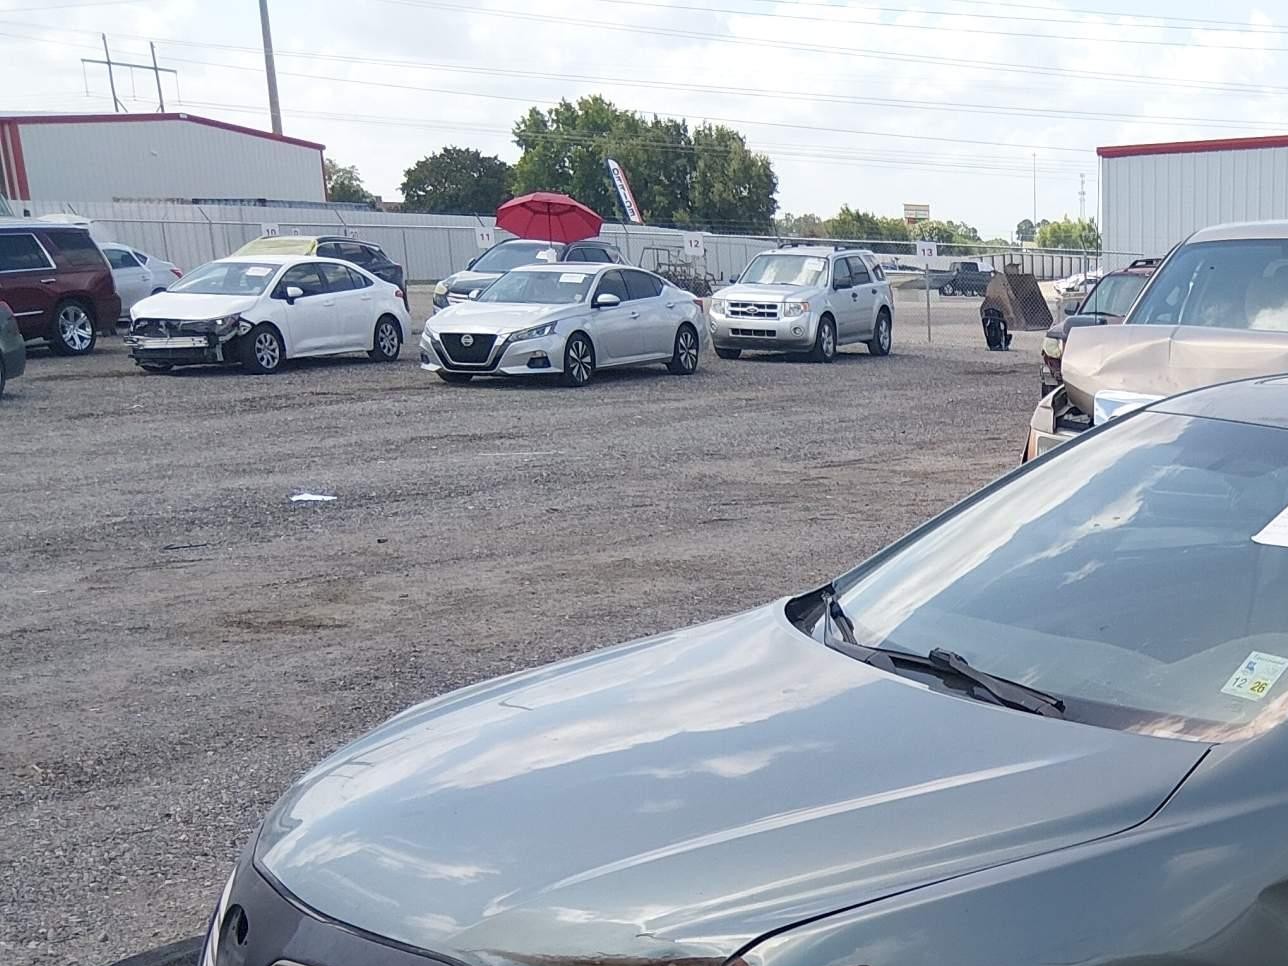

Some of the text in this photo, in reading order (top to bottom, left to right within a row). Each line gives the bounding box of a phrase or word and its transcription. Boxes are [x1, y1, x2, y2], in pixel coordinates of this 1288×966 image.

[611, 167, 636, 217] OFFICE
[480, 233, 490, 241] 11
[689, 239, 700, 248] 12
[921, 248, 933, 257] 13
[1231, 676, 1268, 693] 12 26
